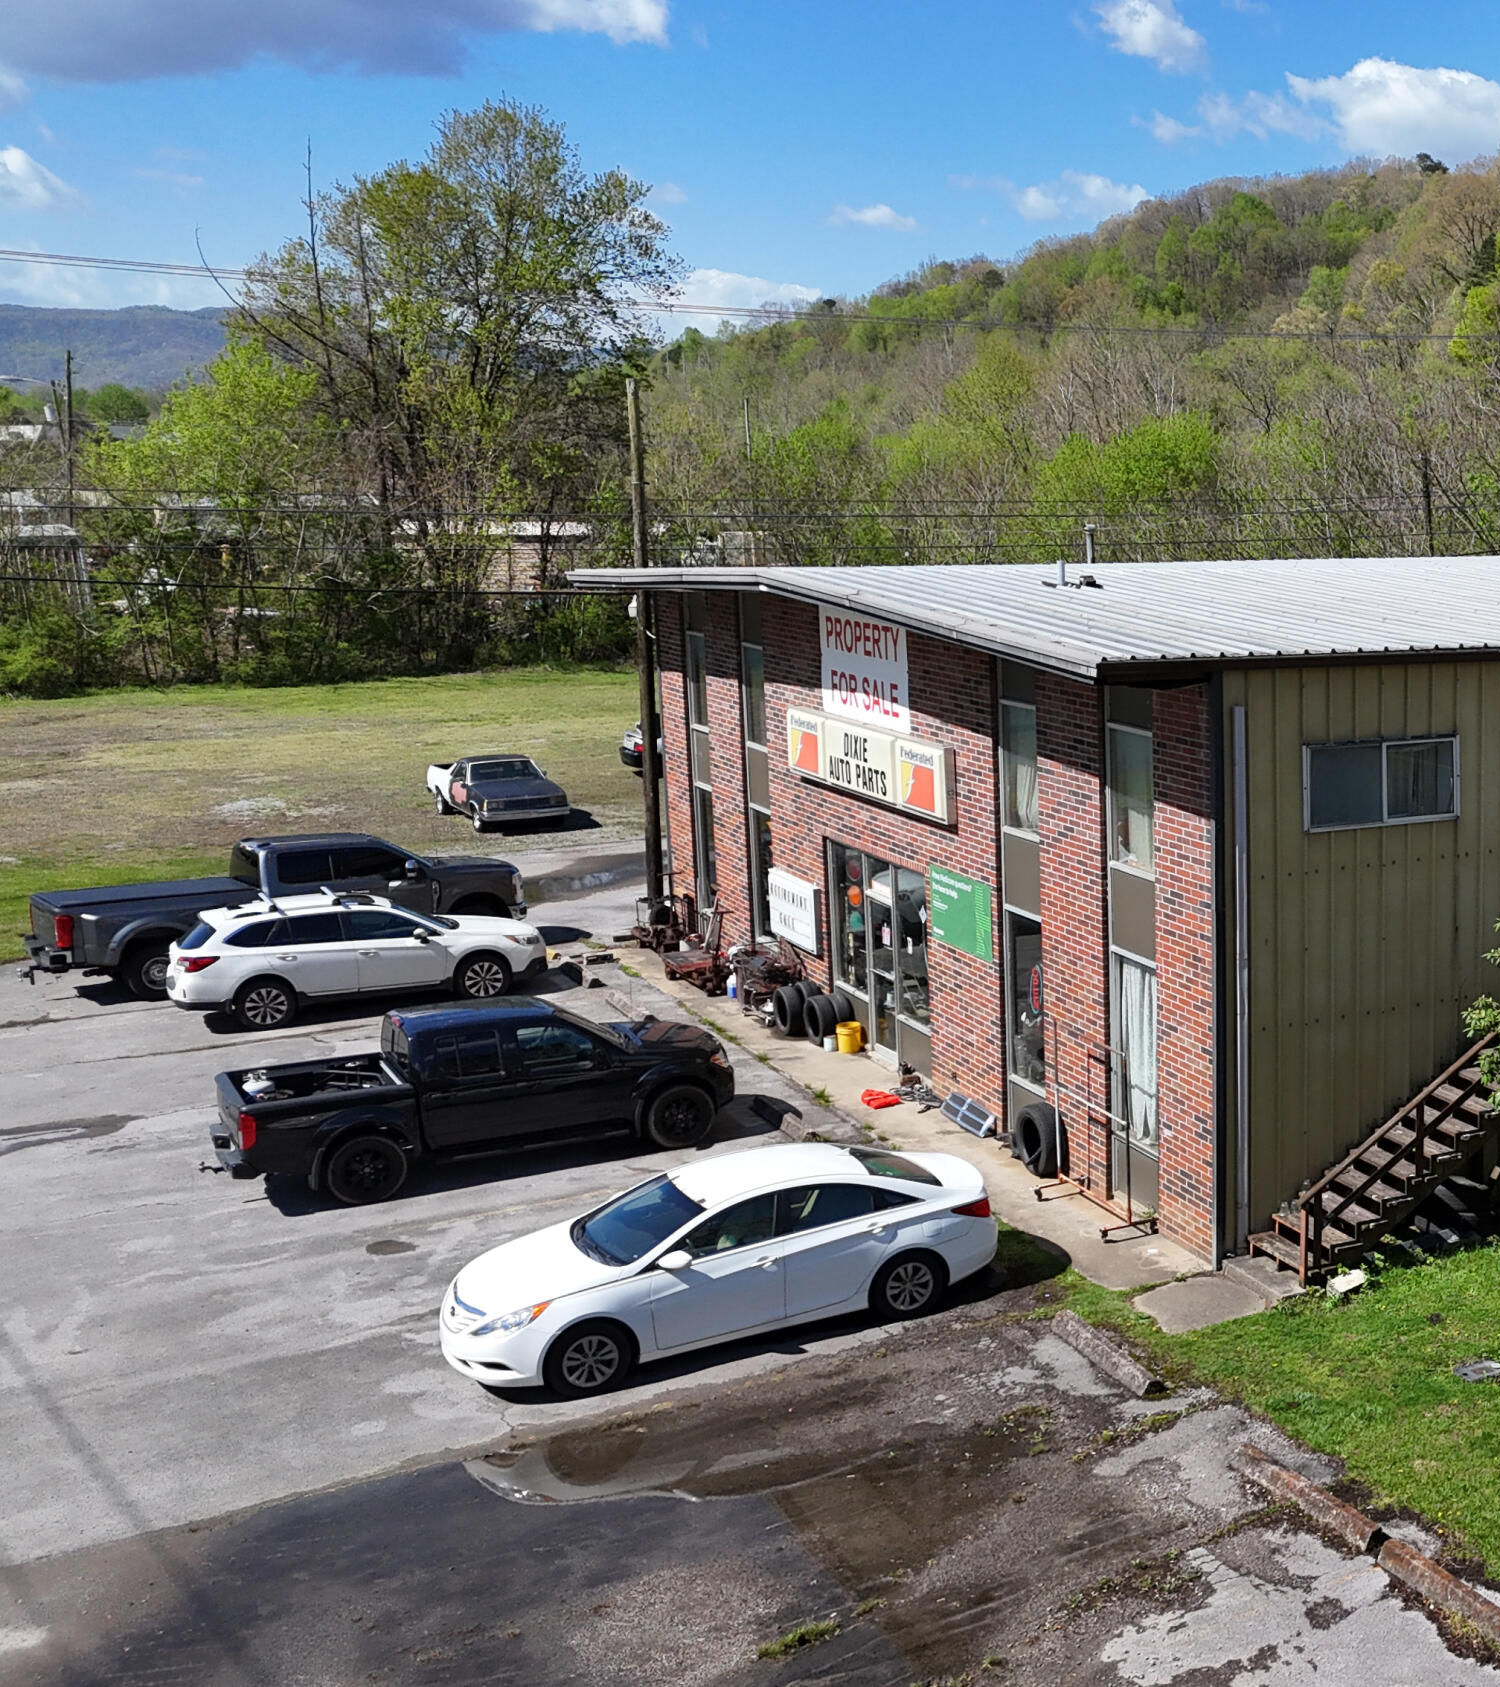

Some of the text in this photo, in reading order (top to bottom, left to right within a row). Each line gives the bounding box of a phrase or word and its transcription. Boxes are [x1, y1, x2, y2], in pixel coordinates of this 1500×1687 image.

[825, 616, 899, 662] PROPERTY
[830, 669, 899, 717] FOR SALE
[789, 714, 818, 732] Federated
[844, 732, 868, 762] DIXIE
[900, 747, 934, 766] Federated
[829, 755, 888, 796] AUTO PARTS
